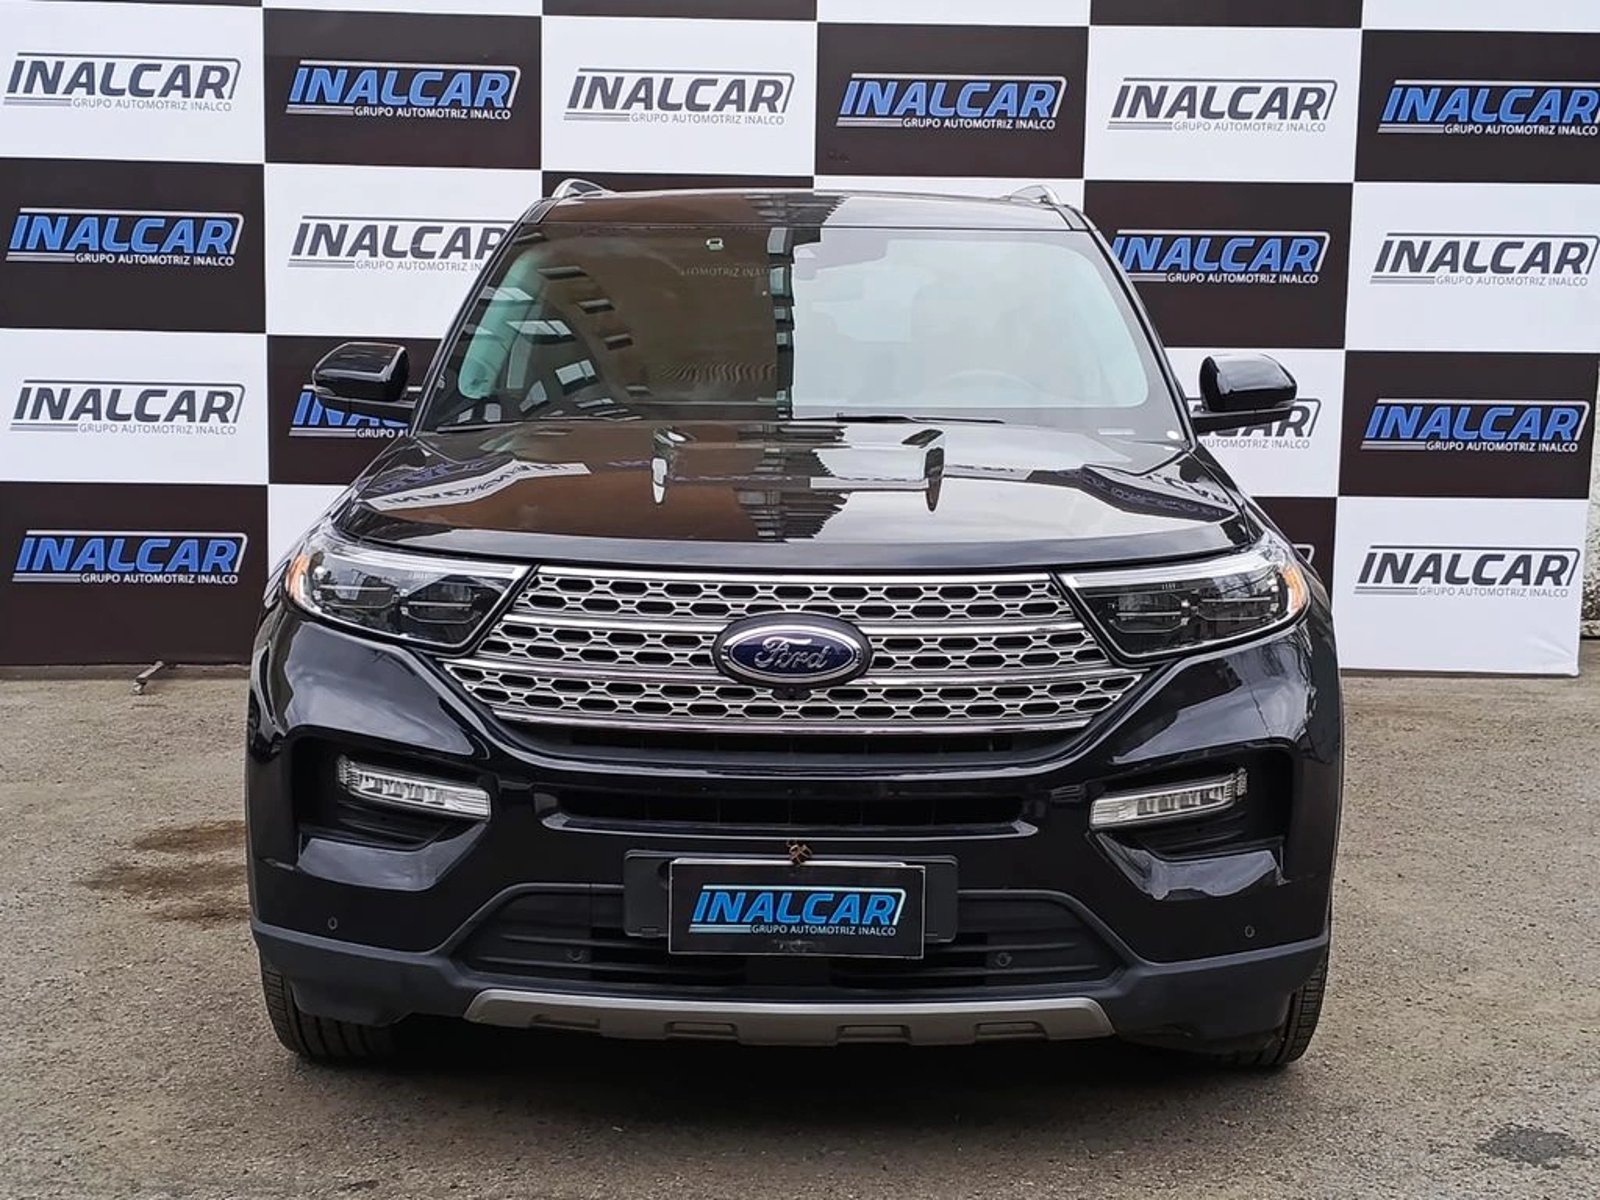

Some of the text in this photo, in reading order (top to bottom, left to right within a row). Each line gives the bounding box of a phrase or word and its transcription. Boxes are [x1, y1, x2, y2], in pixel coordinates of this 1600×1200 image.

[7, 60, 230, 99] INALCAR
[289, 68, 510, 108] INALCAR
[567, 76, 784, 113] INALCAR
[840, 81, 1055, 118] INALCAR
[73, 99, 232, 111] GRUPO AUTOMOTRIZ INALCO
[1111, 85, 1327, 120] INALCAR
[1382, 87, 1600, 123] INALCAR
[355, 107, 511, 119] GRUPO AUTOMOTRIZ INALCO
[631, 113, 784, 125] GRUPO AUTOMOTRIZ INALCO
[903, 118, 1055, 129] GRUPO AUTOMOTRIZ INALCO
[1174, 121, 1325, 132] GRUPO AUTOMOTRIZ INALCO
[1445, 124, 1598, 135] GRUPO AUTOMOTRIZ INALCO
[9, 215, 233, 254] INALCAR
[76, 253, 234, 266] GRUPO AUTOMOTRIZ INALCO
[1374, 240, 1589, 274] INALCAR
[356, 260, 394, 269] GRUPO
[397, 260, 467, 271] AUTOMOTRIZ
[1168, 273, 1318, 284] GRUPO AUTOMOTRIZ INALCO
[1437, 276, 1588, 286] GRUPO AUTOMOTRIZ INALCO
[13, 387, 234, 423] INALCAR
[79, 423, 237, 435] GRUPO AUTOMOTRIZ INALCO
[1365, 406, 1579, 441] INALCAR
[357, 428, 395, 438] GRUPO
[1271, 440, 1310, 449] INALCO
[1427, 442, 1578, 452] GRUPO AUTOMOTRIZ INALCO
[16, 537, 237, 573] INALCAR
[1358, 553, 1570, 586] INALCAR
[82, 573, 238, 584] GRUPO AUTOMOTRIZ INALCO
[1420, 587, 1568, 597] GRUPO AUTOMOTRIZ INALCO
[754, 636, 831, 668] Ford
[692, 892, 896, 926] INALCAR
[752, 925, 896, 936] GRUPO AUTOMOTRIZ INALCO
